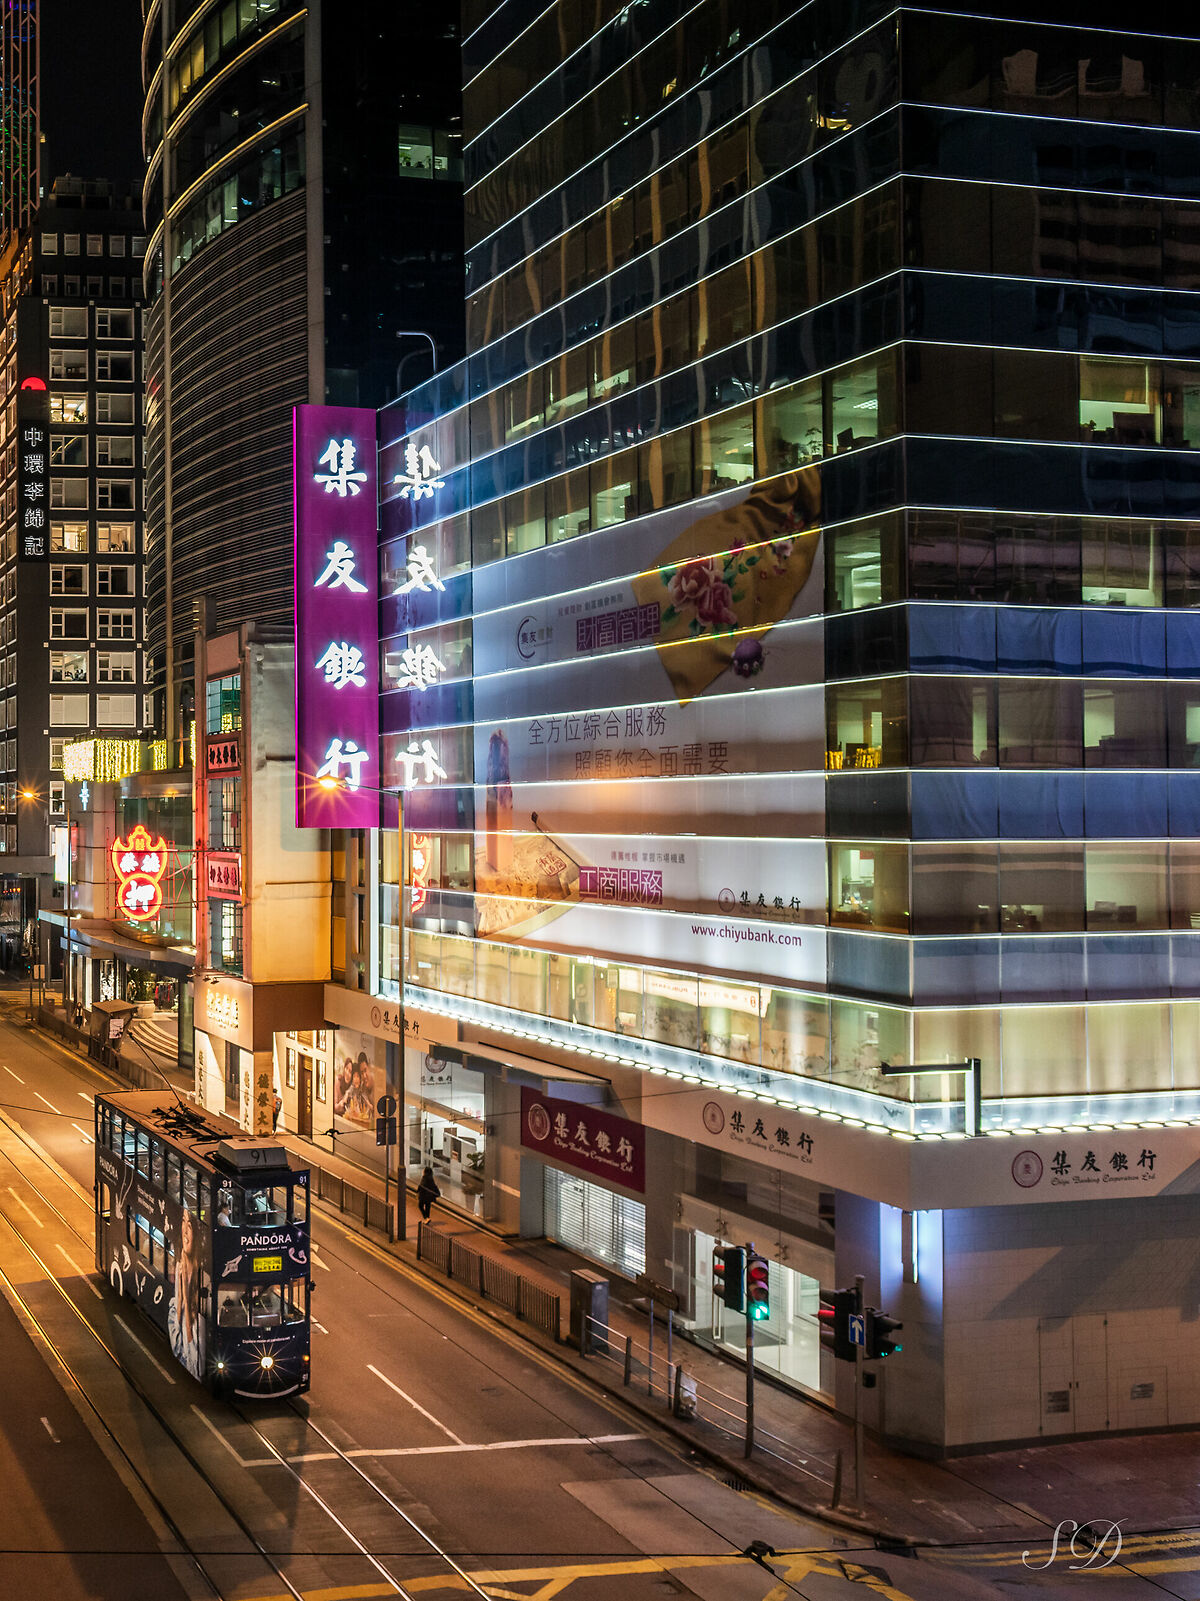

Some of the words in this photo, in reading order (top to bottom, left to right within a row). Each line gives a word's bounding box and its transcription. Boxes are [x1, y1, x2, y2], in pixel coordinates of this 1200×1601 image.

[24, 427, 45, 556] 中環李錦記
[313, 439, 370, 792] 集友銀行
[577, 603, 660, 651] 財富管理
[528, 705, 667, 745] 全方位綜合服務
[579, 866, 663, 905] 工商服務
[739, 890, 801, 913] 集友銀行
[691, 923, 802, 947] www.chiyubank.com
[554, 1112, 634, 1163] 集友銀行
[729, 1110, 814, 1155] 集友銀行
[251, 1150, 267, 1164] 91
[1051, 1149, 1157, 1176] 集友銀行
[222, 1180, 232, 1188] 91
[299, 1176, 307, 1184] 91
[240, 1233, 292, 1246] PANDORA
